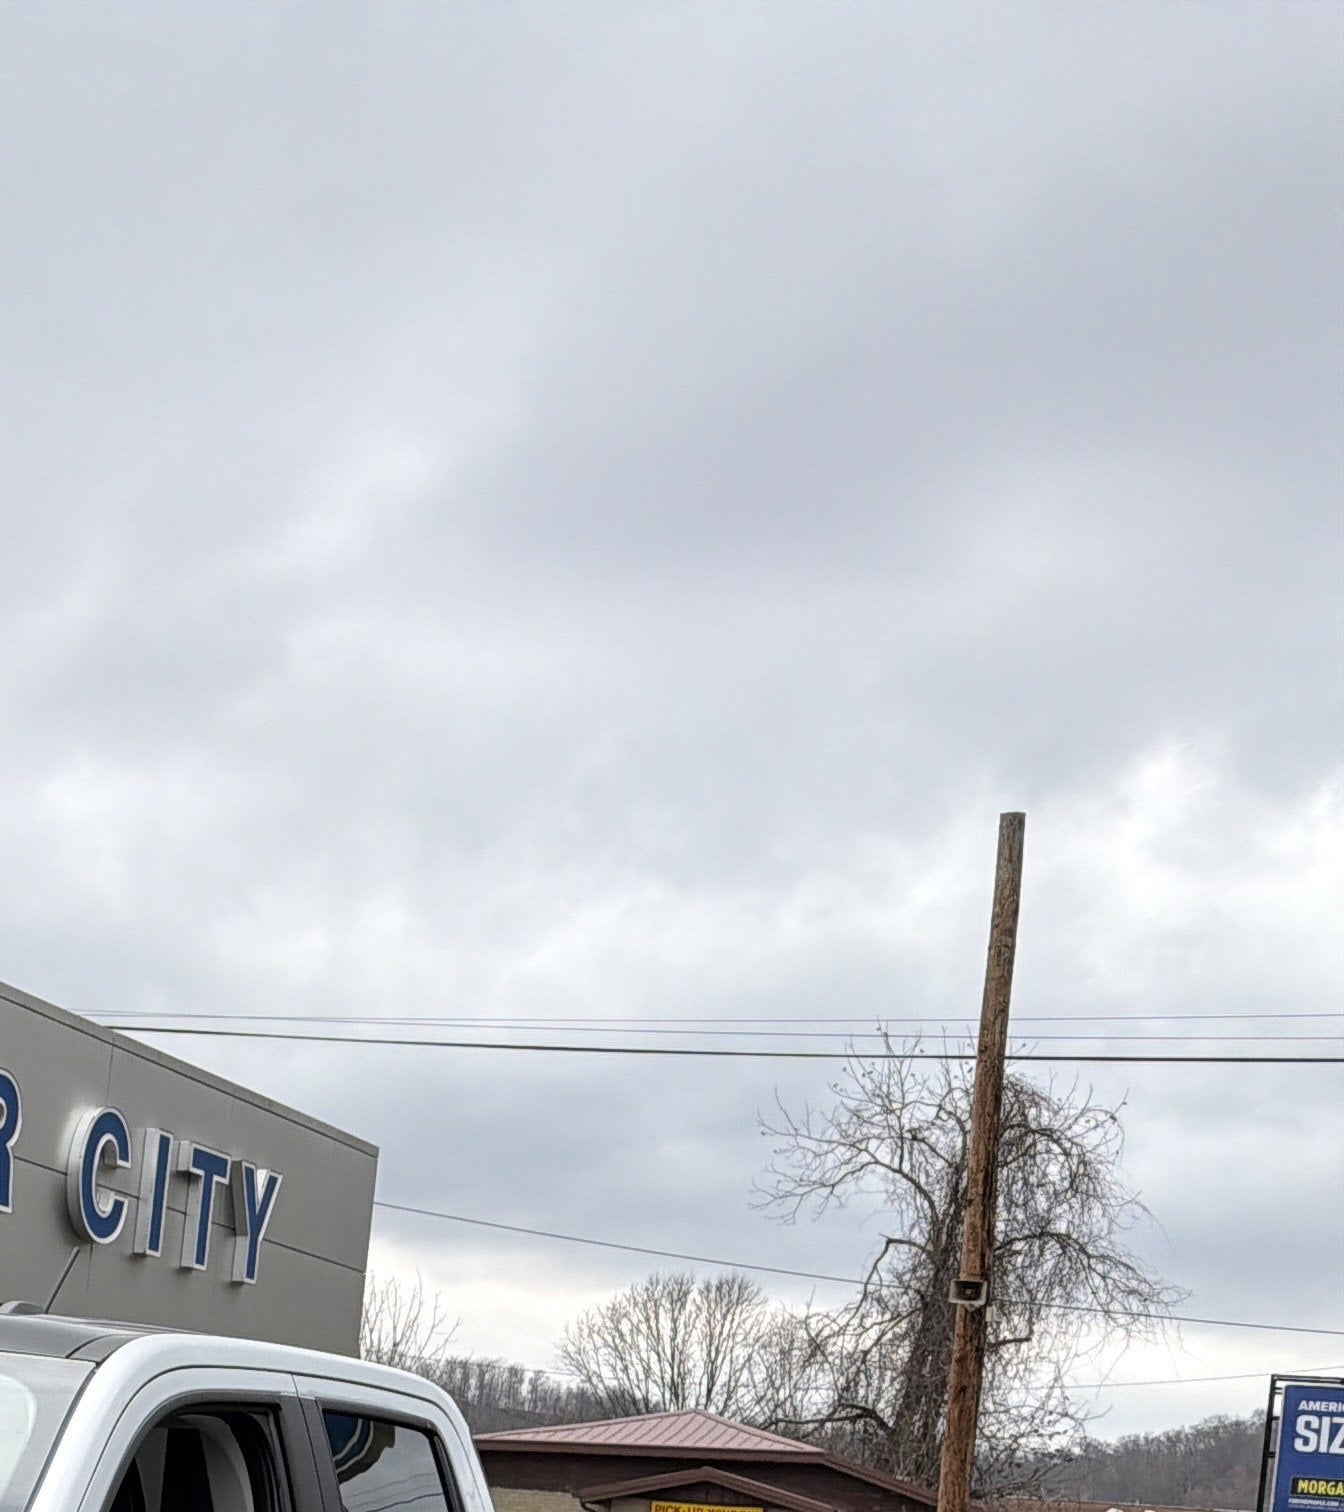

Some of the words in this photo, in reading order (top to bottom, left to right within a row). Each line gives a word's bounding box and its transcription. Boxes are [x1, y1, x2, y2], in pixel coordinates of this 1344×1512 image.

[67, 1106, 283, 1284] CITY
[1298, 1400, 1344, 1413] AMERI
[1294, 1414, 1344, 1455] SIZ
